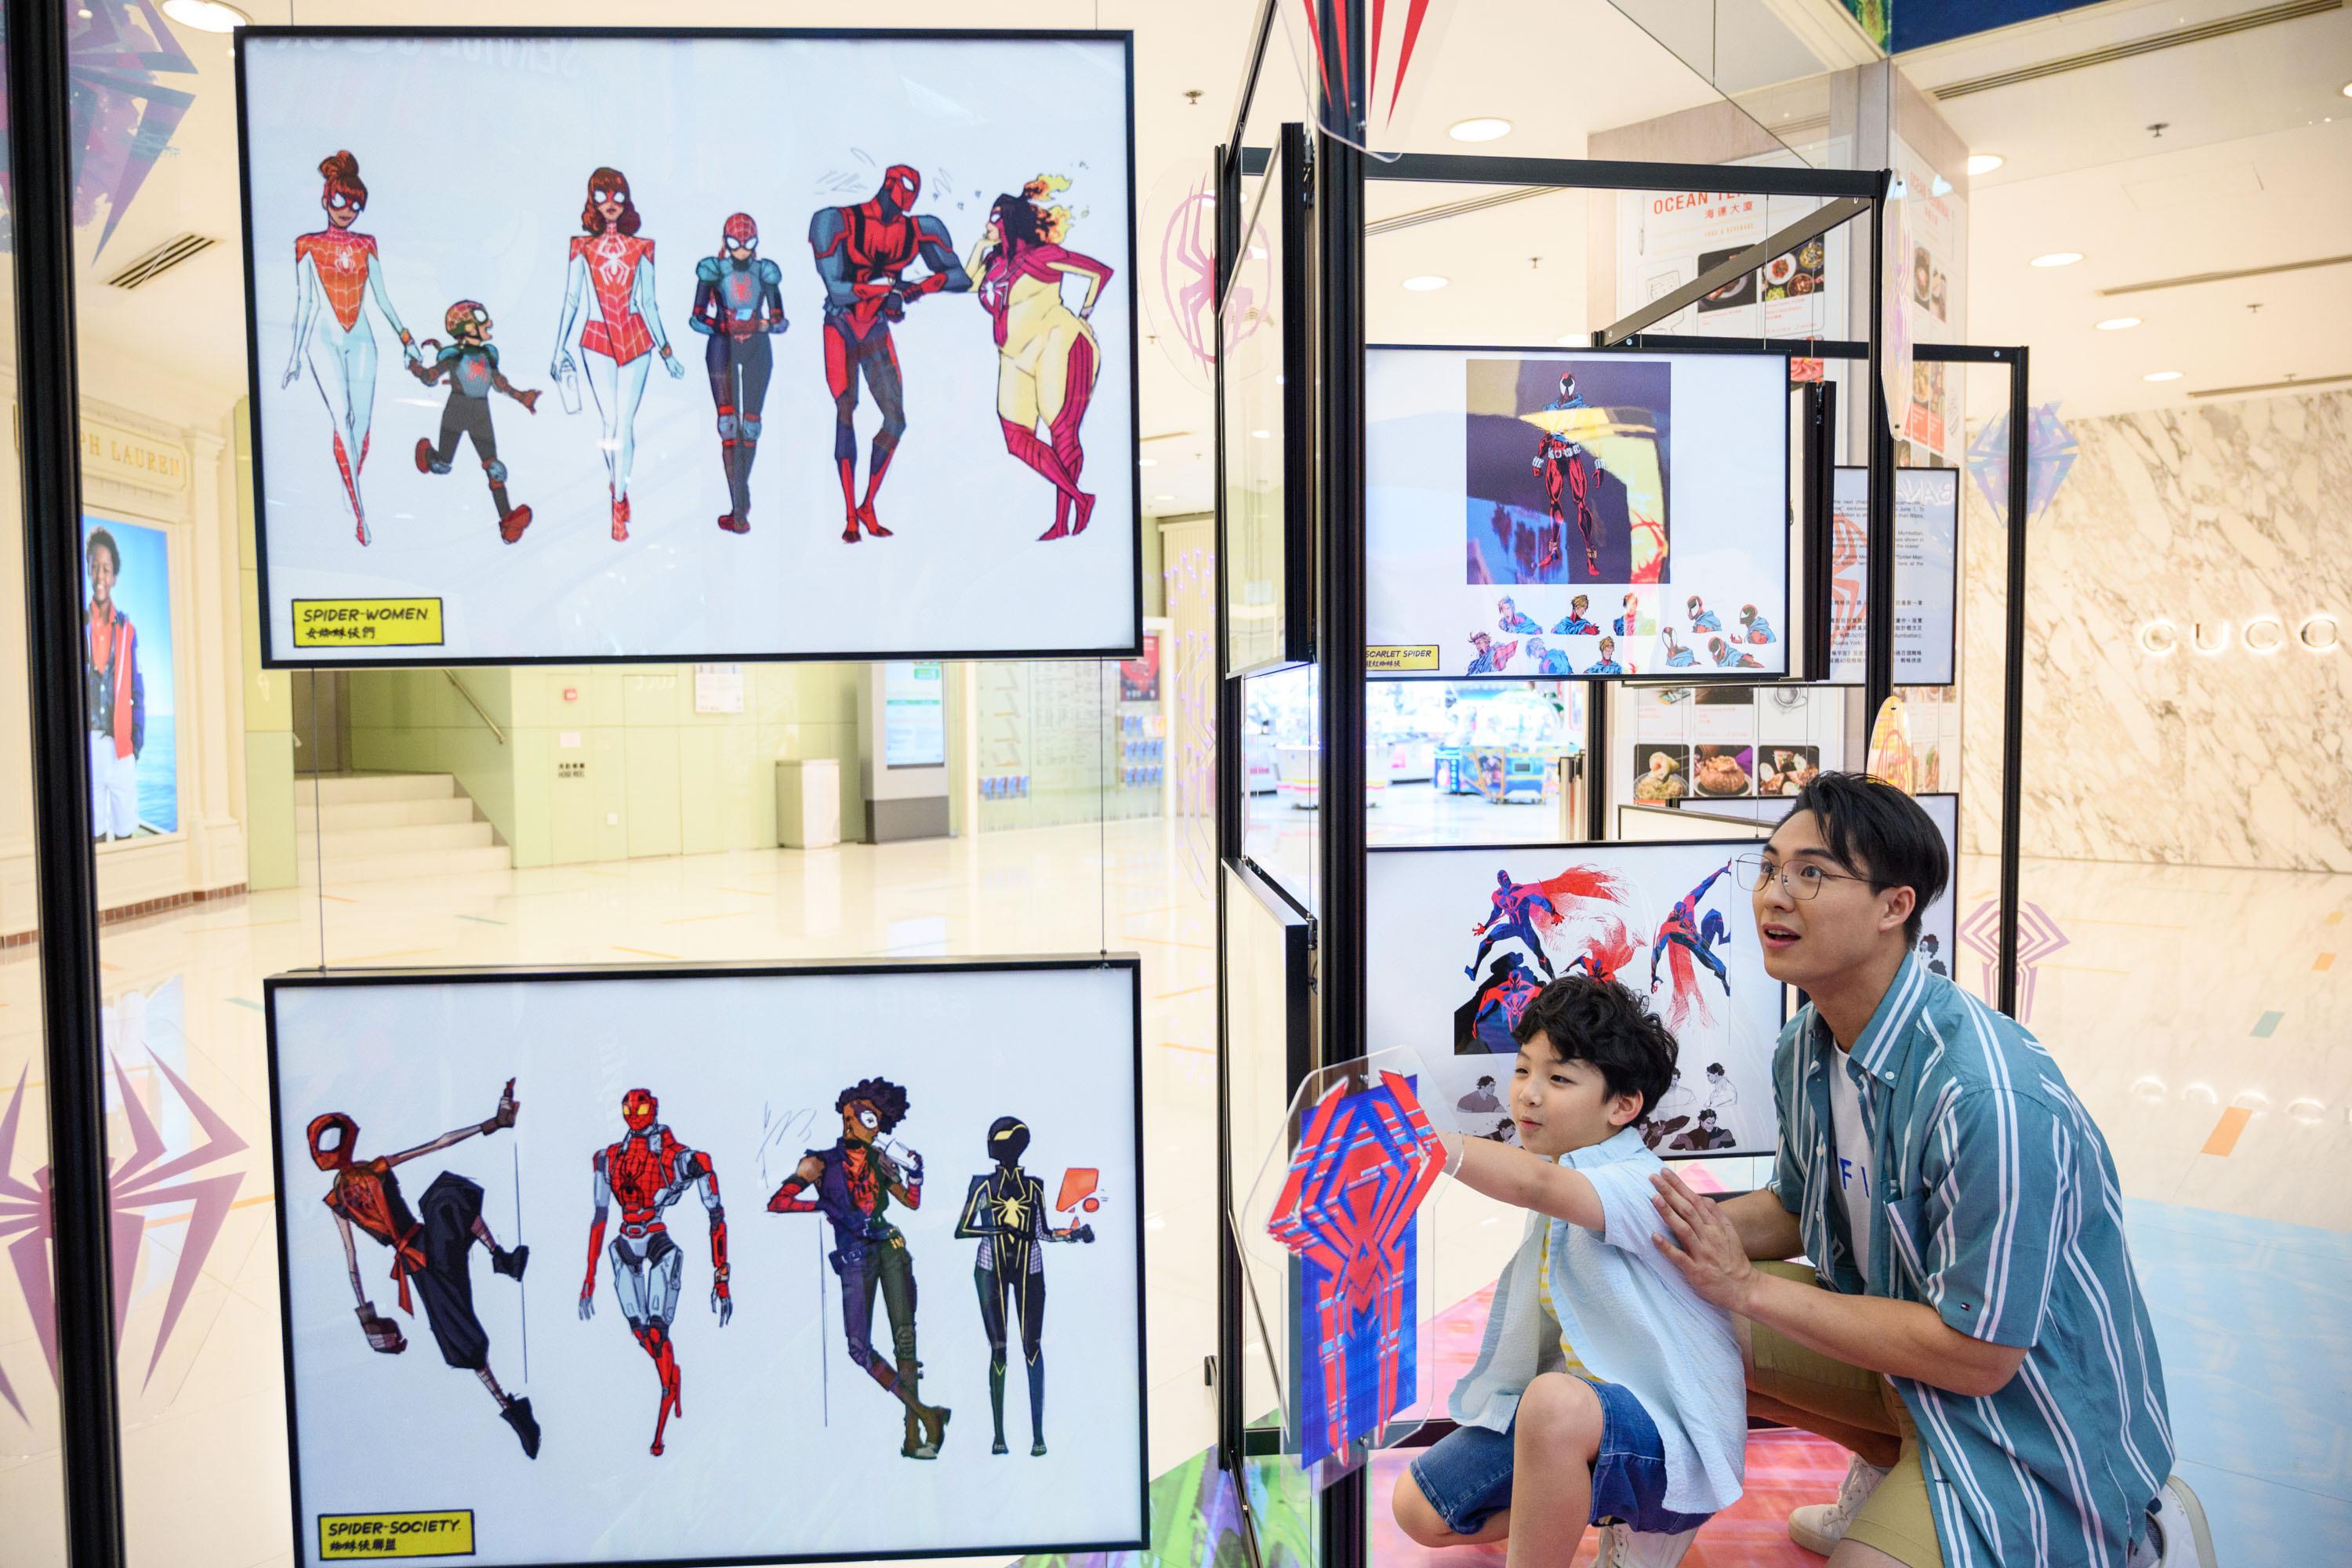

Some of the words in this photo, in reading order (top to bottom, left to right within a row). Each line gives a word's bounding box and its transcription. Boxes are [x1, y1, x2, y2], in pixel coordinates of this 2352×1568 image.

[1653, 191, 1708, 214] OCEAN
[111, 441, 180, 477] LAUREN
[303, 608, 428, 622] SPIDER-WOMEN
[328, 1519, 460, 1537] SPIDER-SOCIETY
